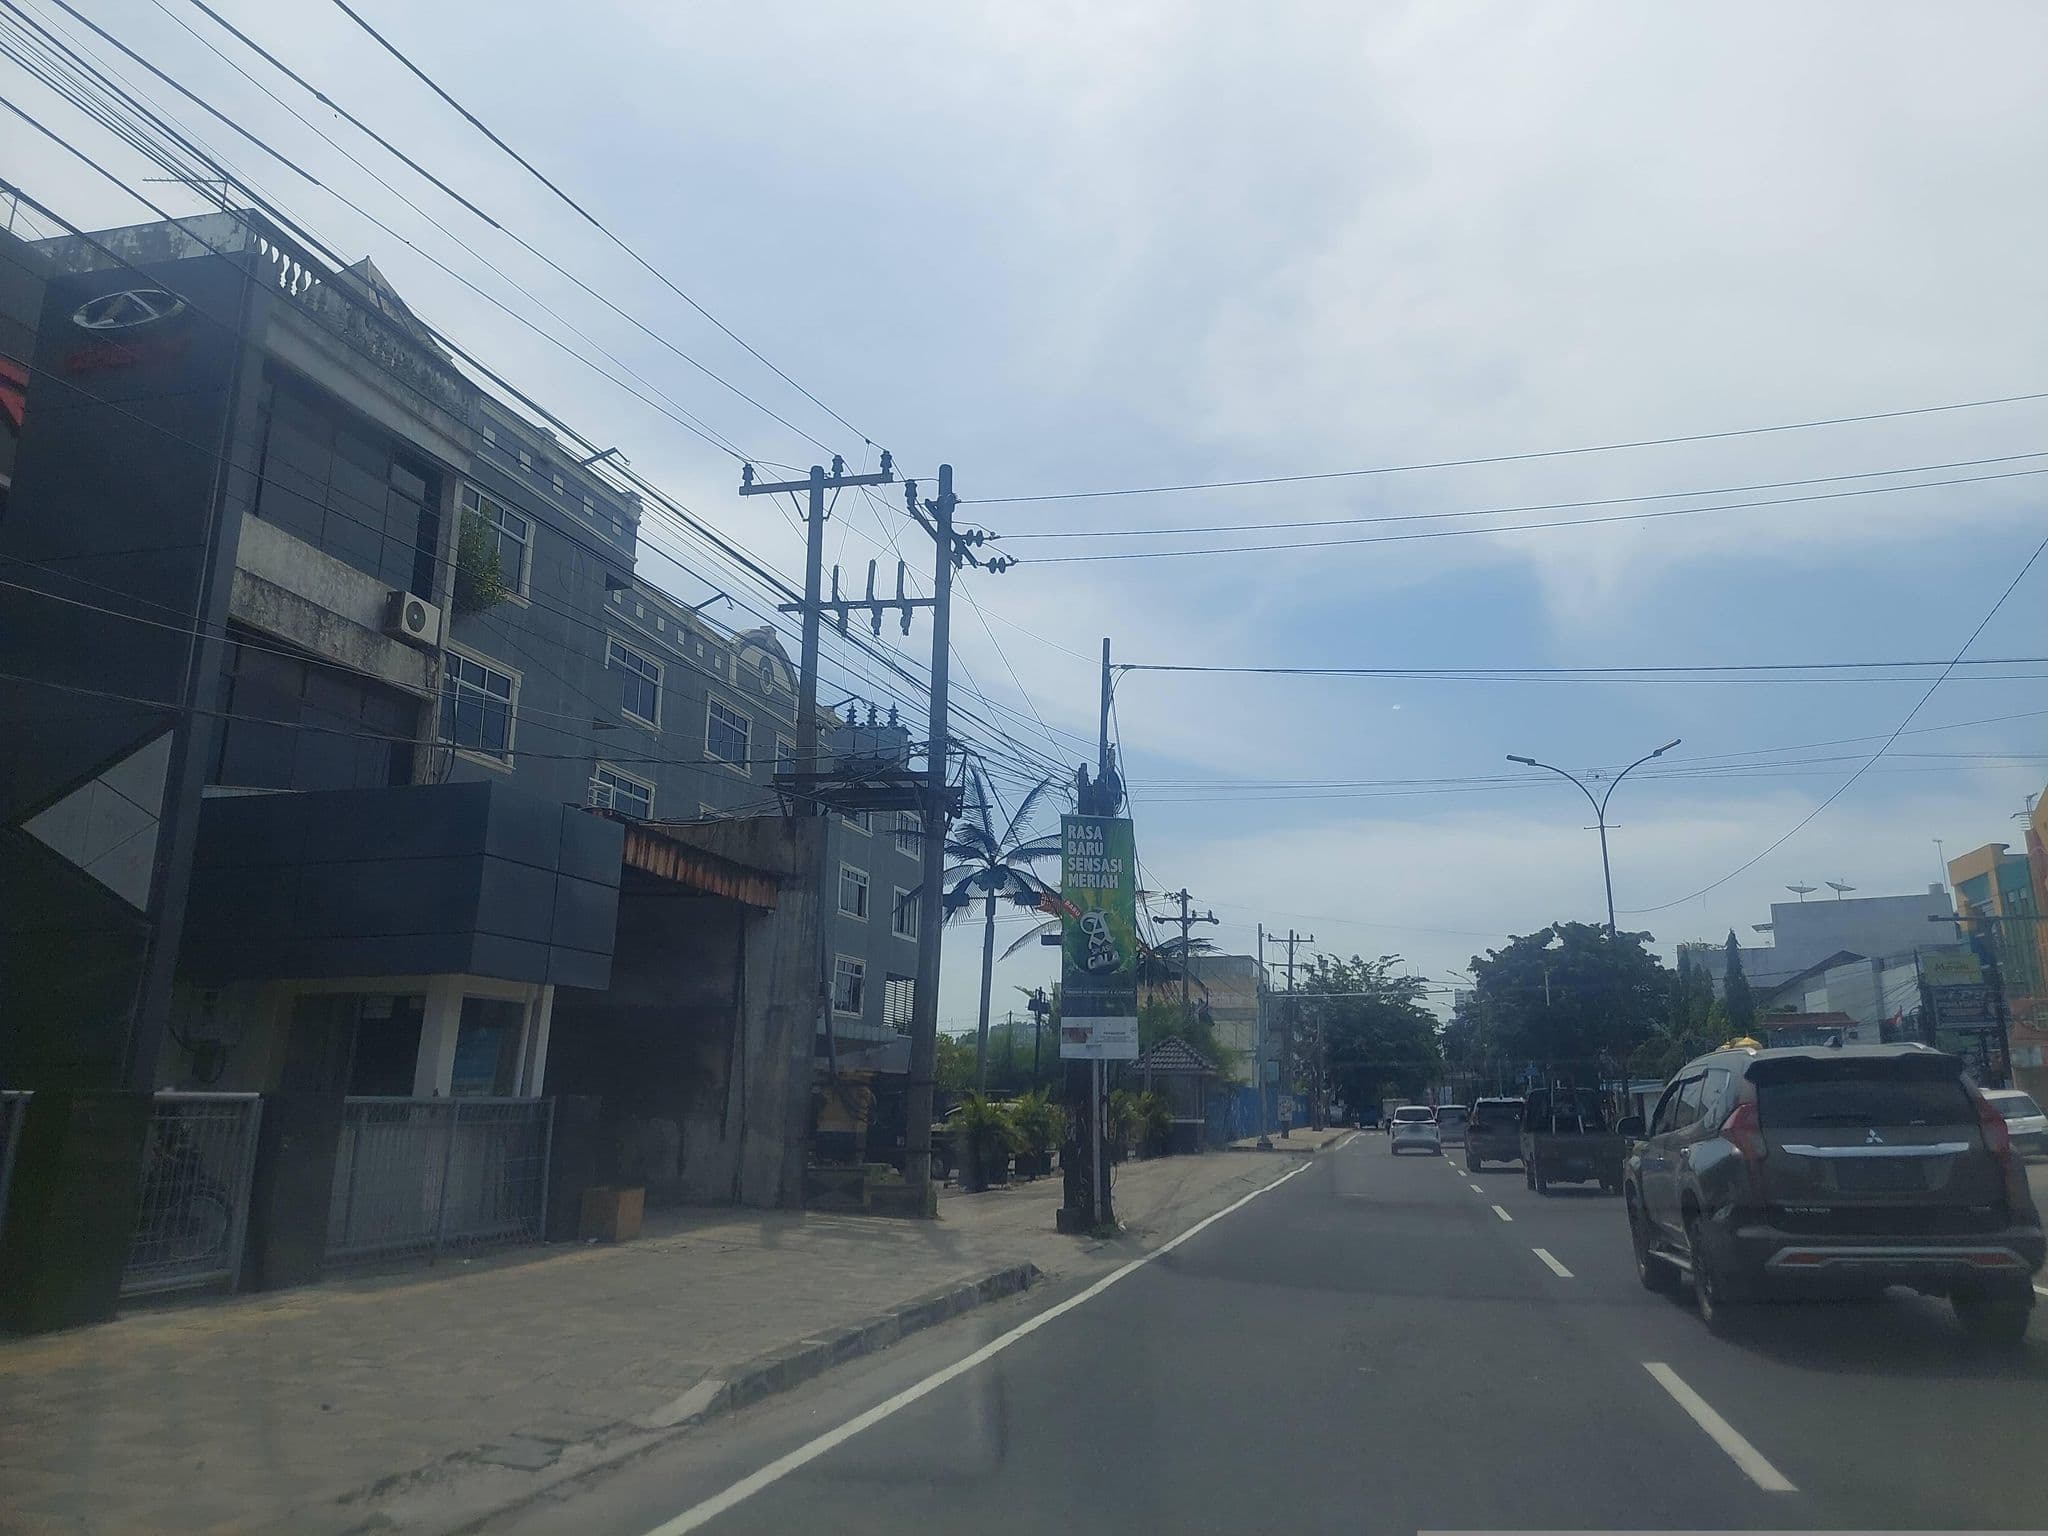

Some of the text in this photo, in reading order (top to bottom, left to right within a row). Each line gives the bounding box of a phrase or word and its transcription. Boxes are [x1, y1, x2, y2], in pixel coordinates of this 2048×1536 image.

[1067, 824, 1103, 840] RASA
[1067, 840, 1104, 856] BARU
[1068, 857, 1123, 873] SENSASI
[1068, 873, 1119, 889] MERIAH
